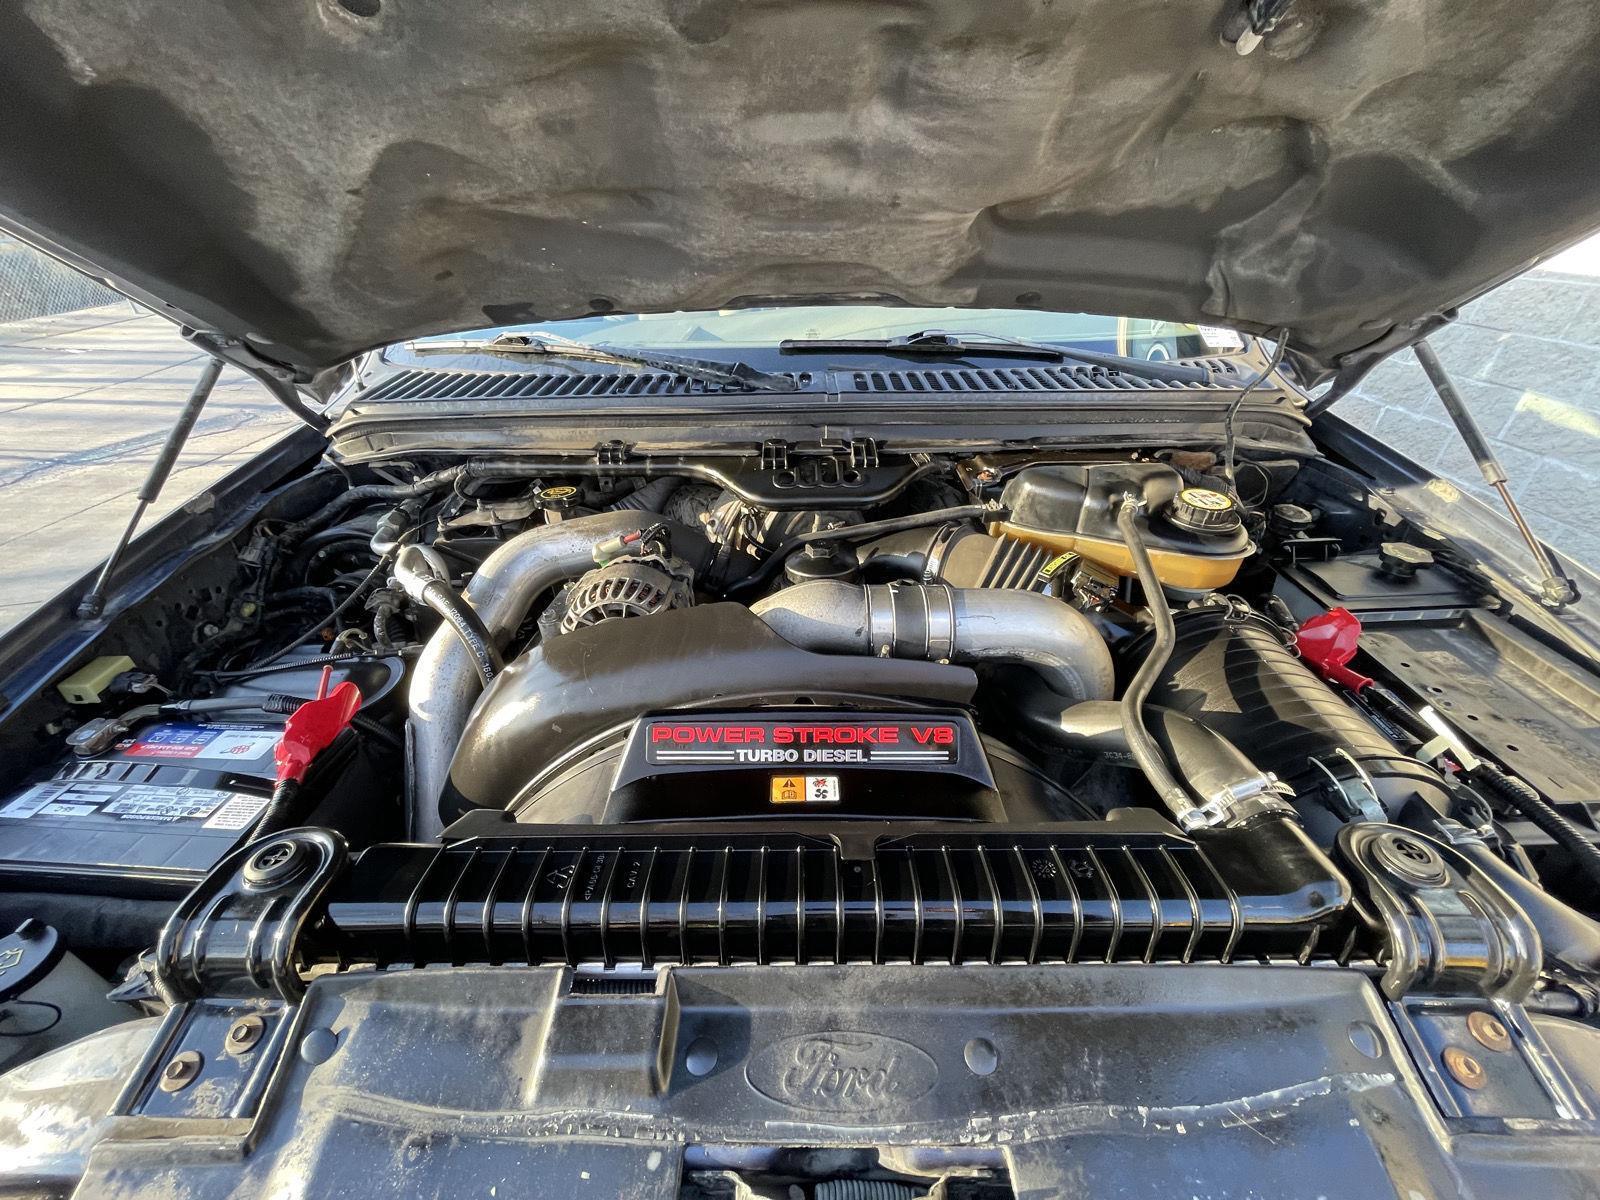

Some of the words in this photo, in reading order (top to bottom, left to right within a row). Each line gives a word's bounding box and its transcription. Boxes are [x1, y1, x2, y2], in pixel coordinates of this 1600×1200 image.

[465, 628, 481, 650] TYPE
[652, 726, 765, 744] POWER
[773, 726, 899, 744] STROKE
[911, 726, 954, 744] V8
[736, 749, 799, 763] TURBO
[803, 749, 868, 763] DIESEL
[783, 1037, 901, 1101] Ford
